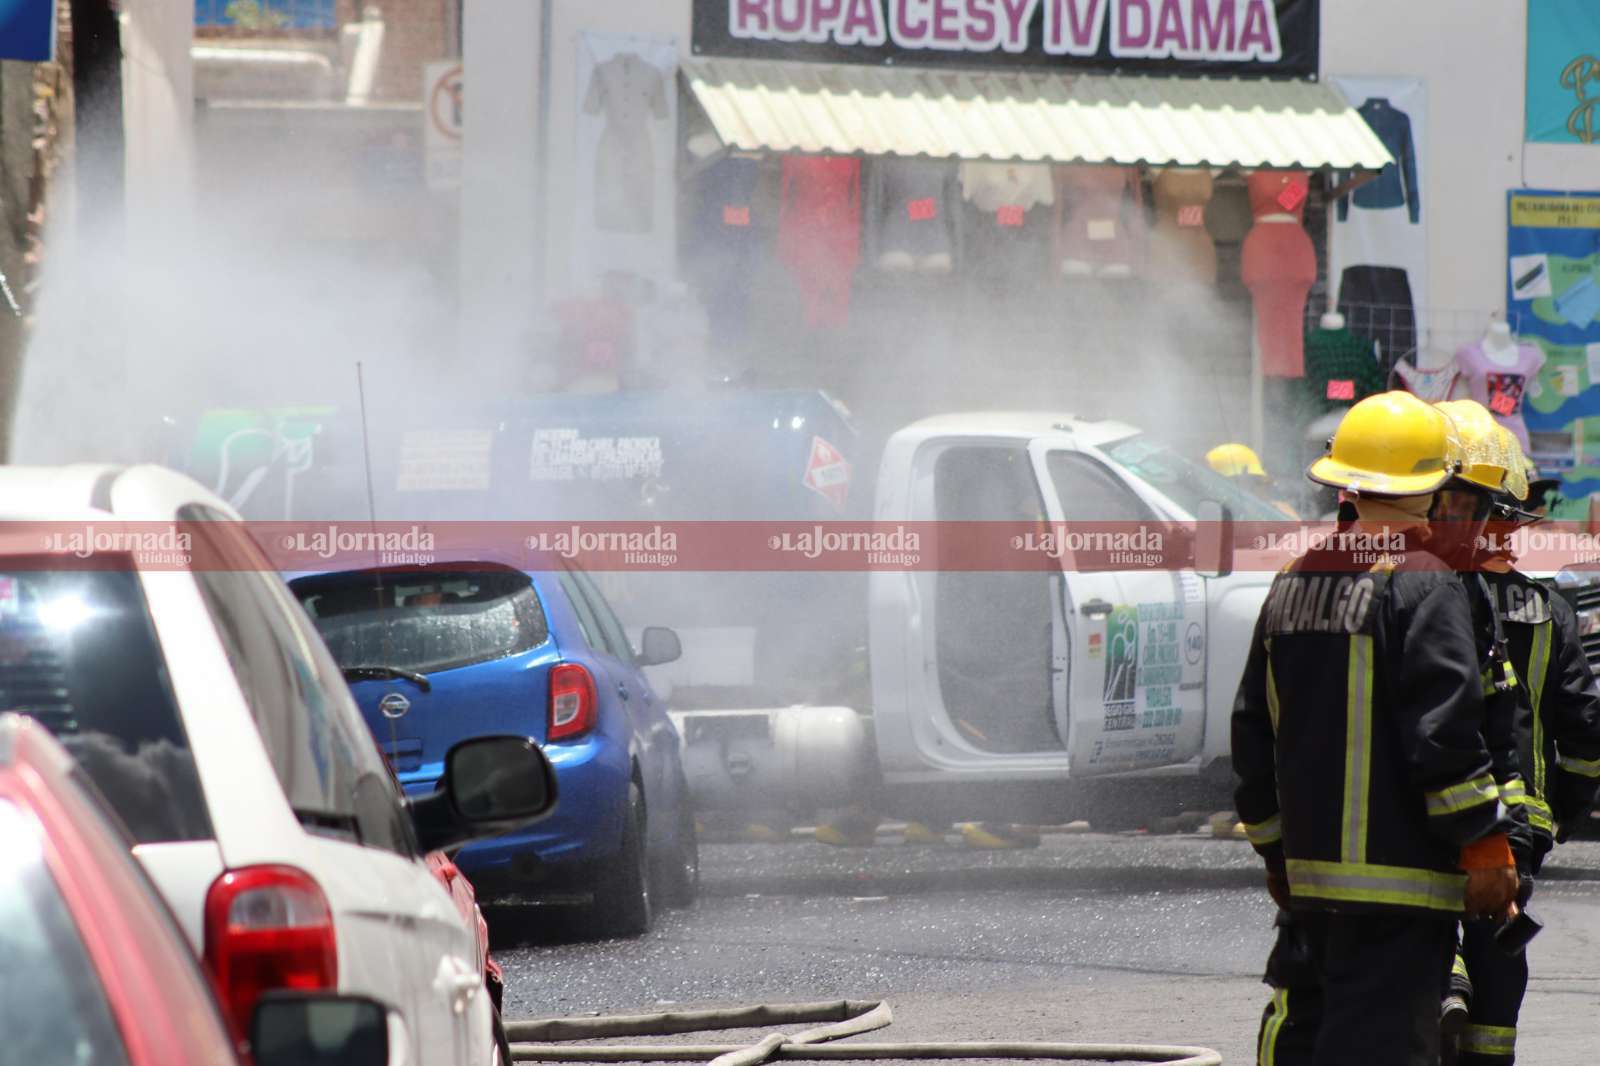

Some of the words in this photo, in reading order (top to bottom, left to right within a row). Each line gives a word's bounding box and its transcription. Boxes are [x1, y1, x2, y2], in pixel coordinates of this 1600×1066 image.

[728, 0, 886, 46] ROPA
[889, 0, 1028, 52] CESY
[1043, 0, 1102, 55] IV
[1109, 0, 1282, 62] DAMA
